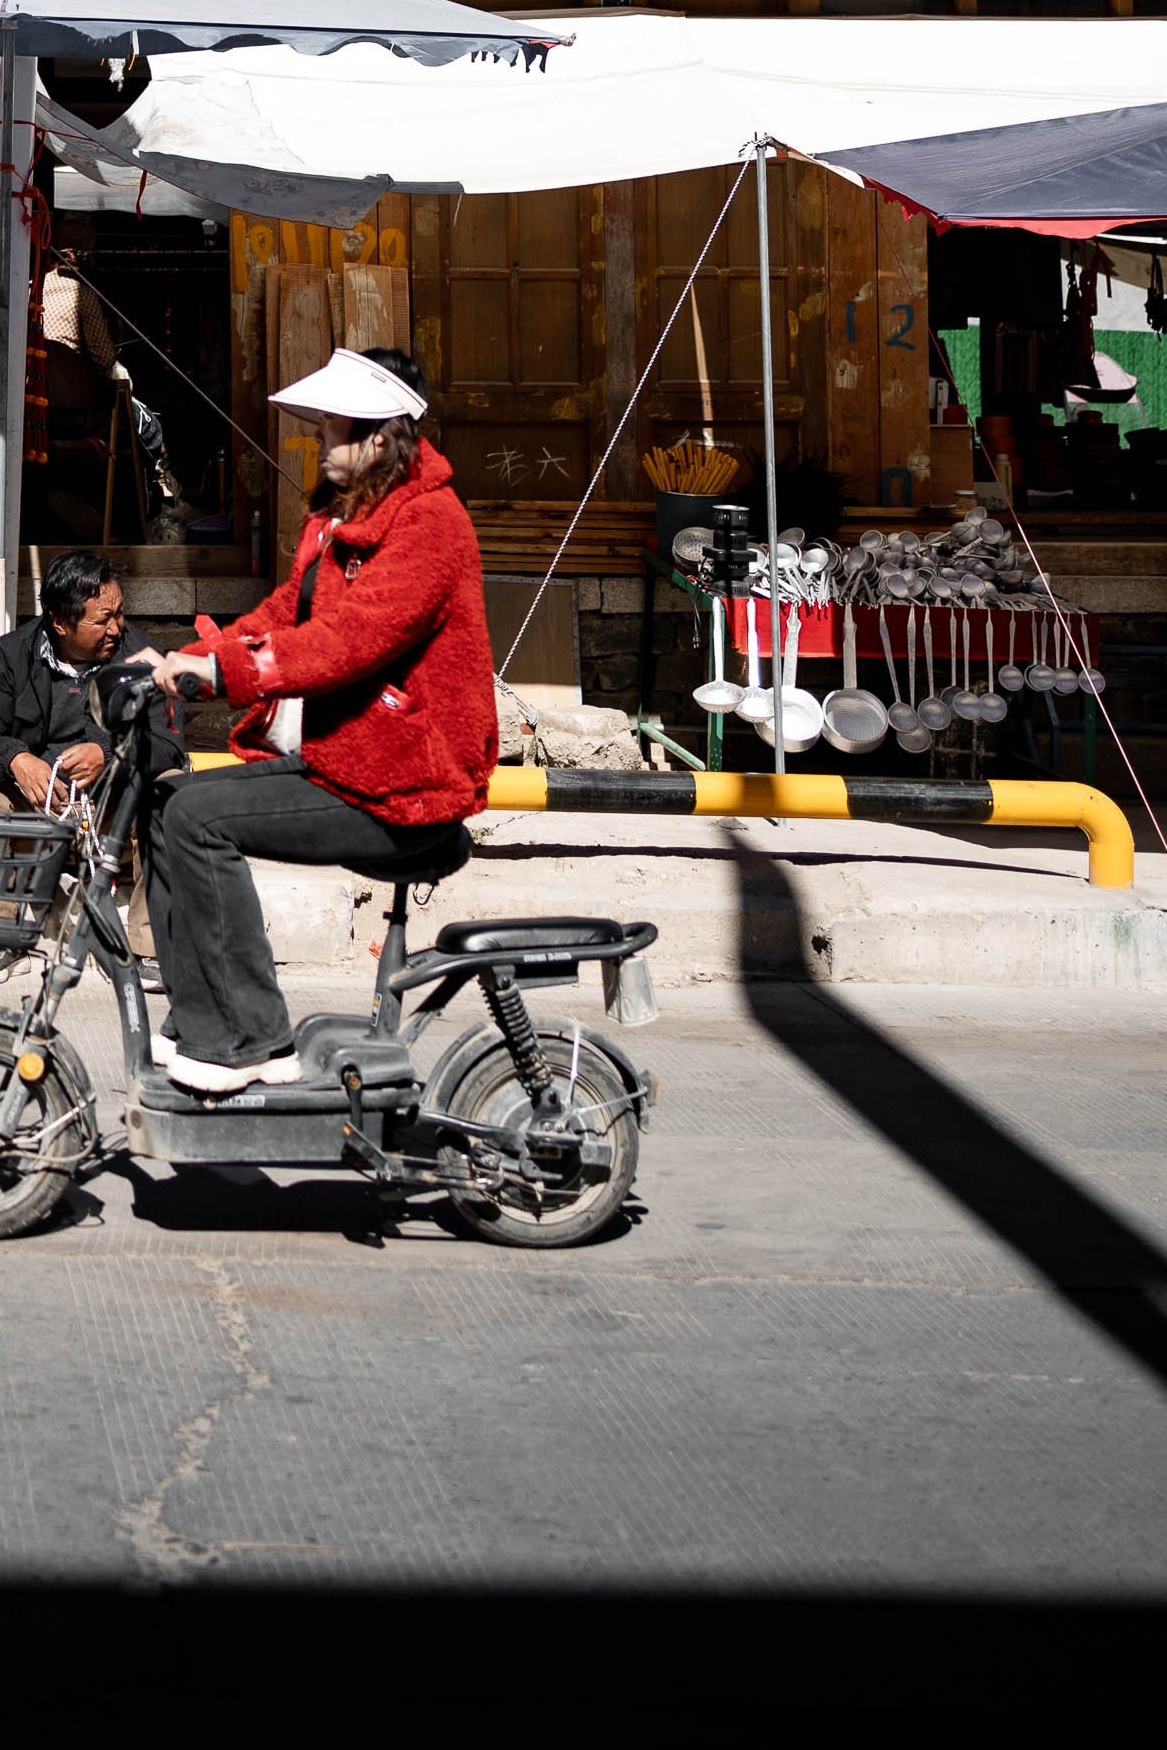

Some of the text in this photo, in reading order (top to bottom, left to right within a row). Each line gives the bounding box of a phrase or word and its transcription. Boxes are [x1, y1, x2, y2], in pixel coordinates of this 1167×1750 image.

[232, 214, 274, 293] 10
[846, 302, 915, 350] 1 2
